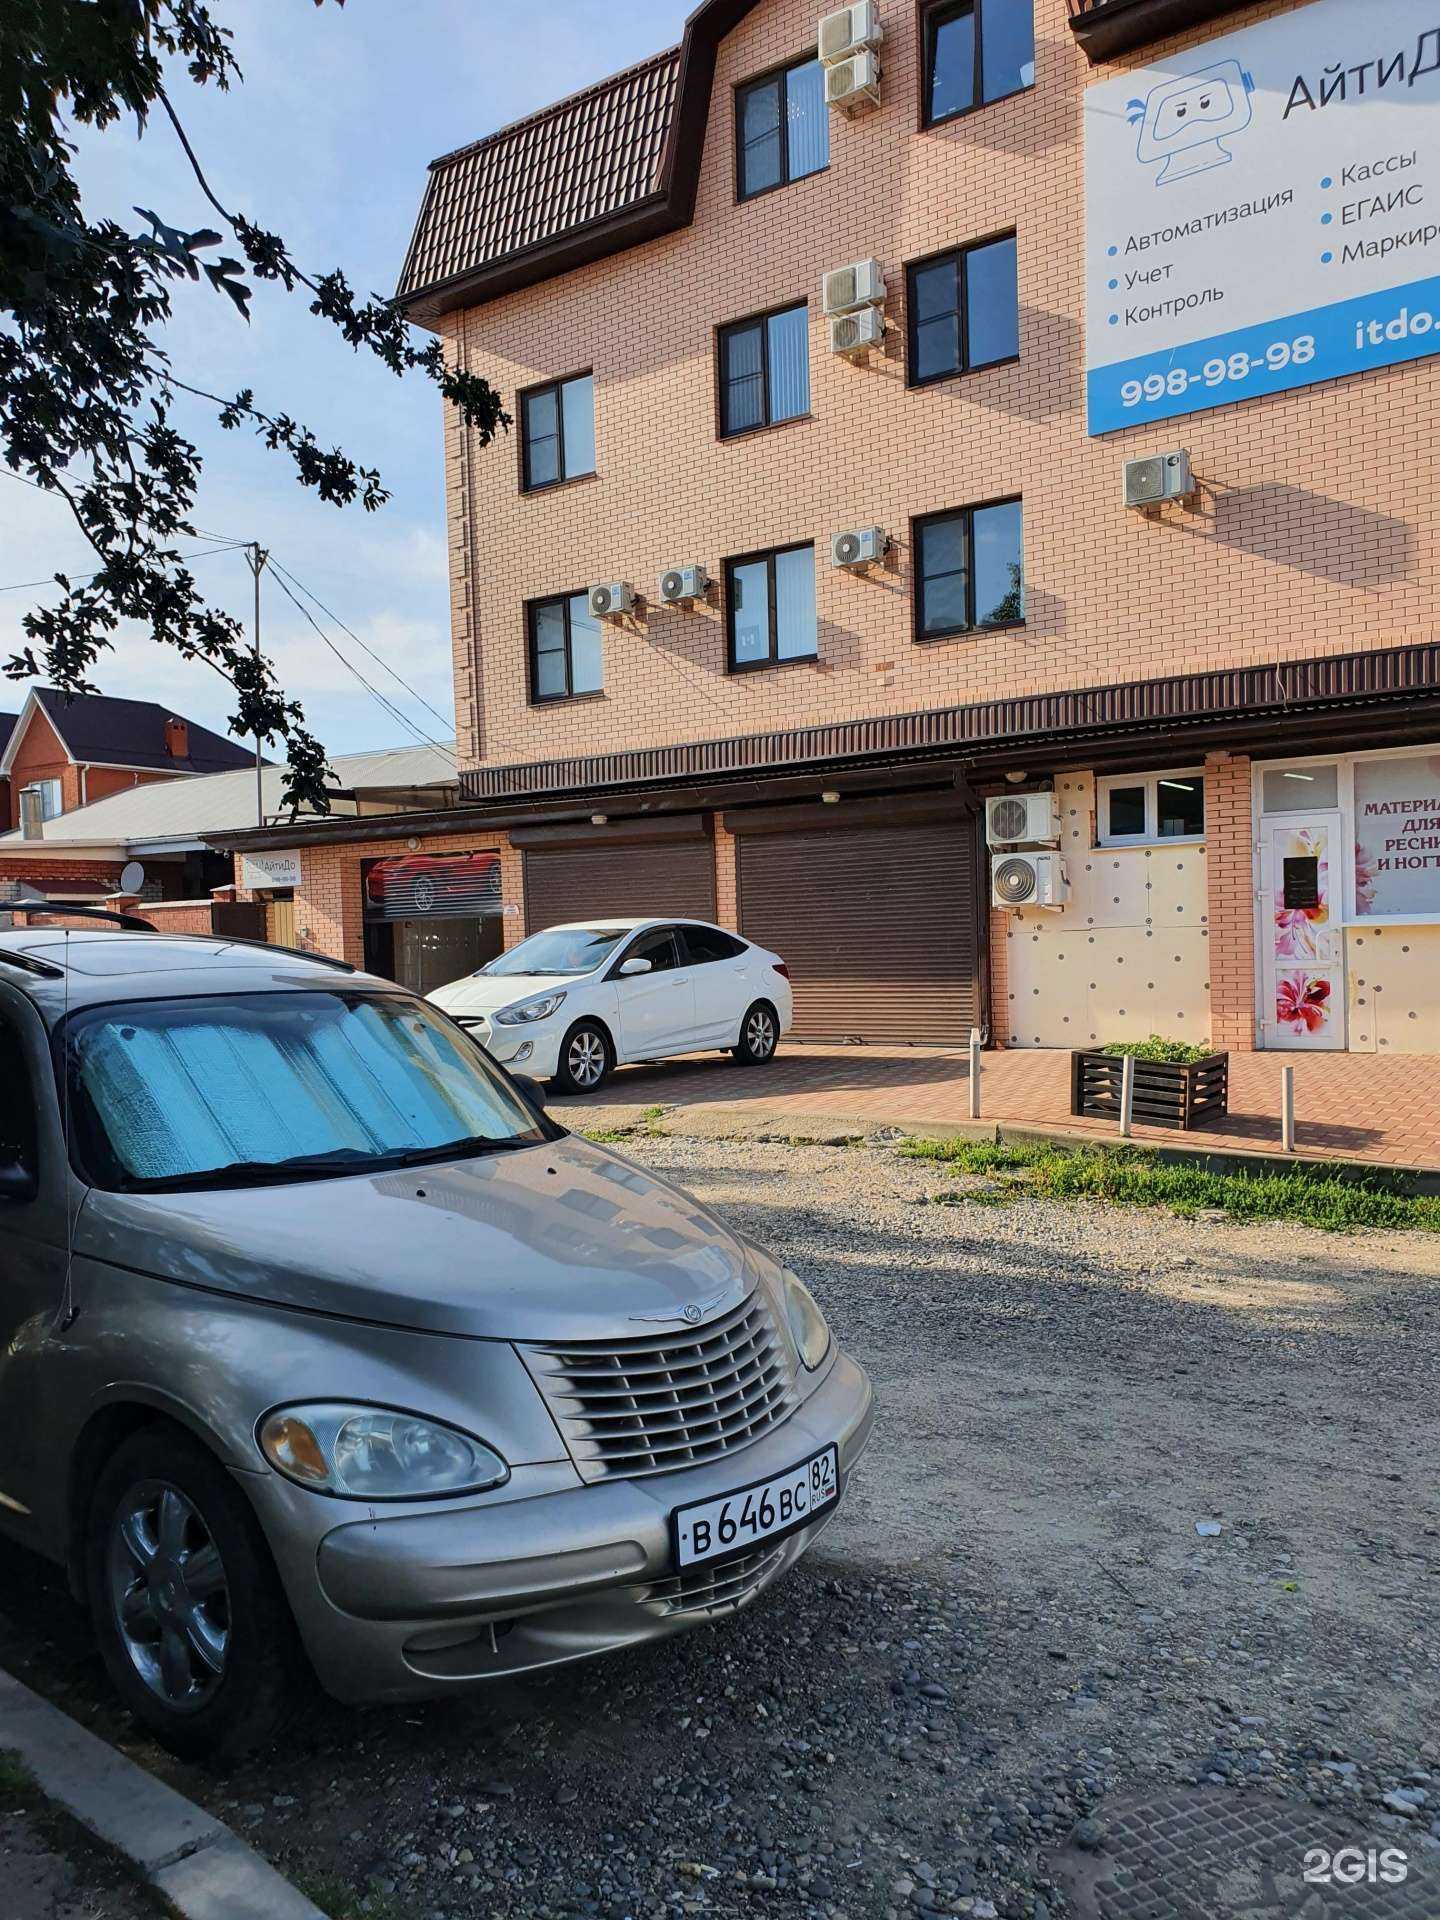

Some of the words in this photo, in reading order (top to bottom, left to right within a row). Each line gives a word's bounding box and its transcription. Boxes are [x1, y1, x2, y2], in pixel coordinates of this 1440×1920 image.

[1341, 151, 1417, 187] Кассы
[1124, 188, 1294, 256] Автоматизация
[1341, 184, 1424, 226] ЕГАИС
[1341, 224, 1440, 264] Маркир
[1124, 264, 1174, 290] Учет
[1125, 285, 1225, 327] Контроль
[1119, 334, 1316, 408] 998-98-98
[1363, 798, 1440, 816] МАТЕРИ
[1402, 817, 1440, 834] ДЛЯ
[1377, 858, 1390, 871] И
[692, 1480, 807, 1556] В646ВС
[811, 1455, 830, 1491] 82
[811, 1488, 826, 1505] RUS
